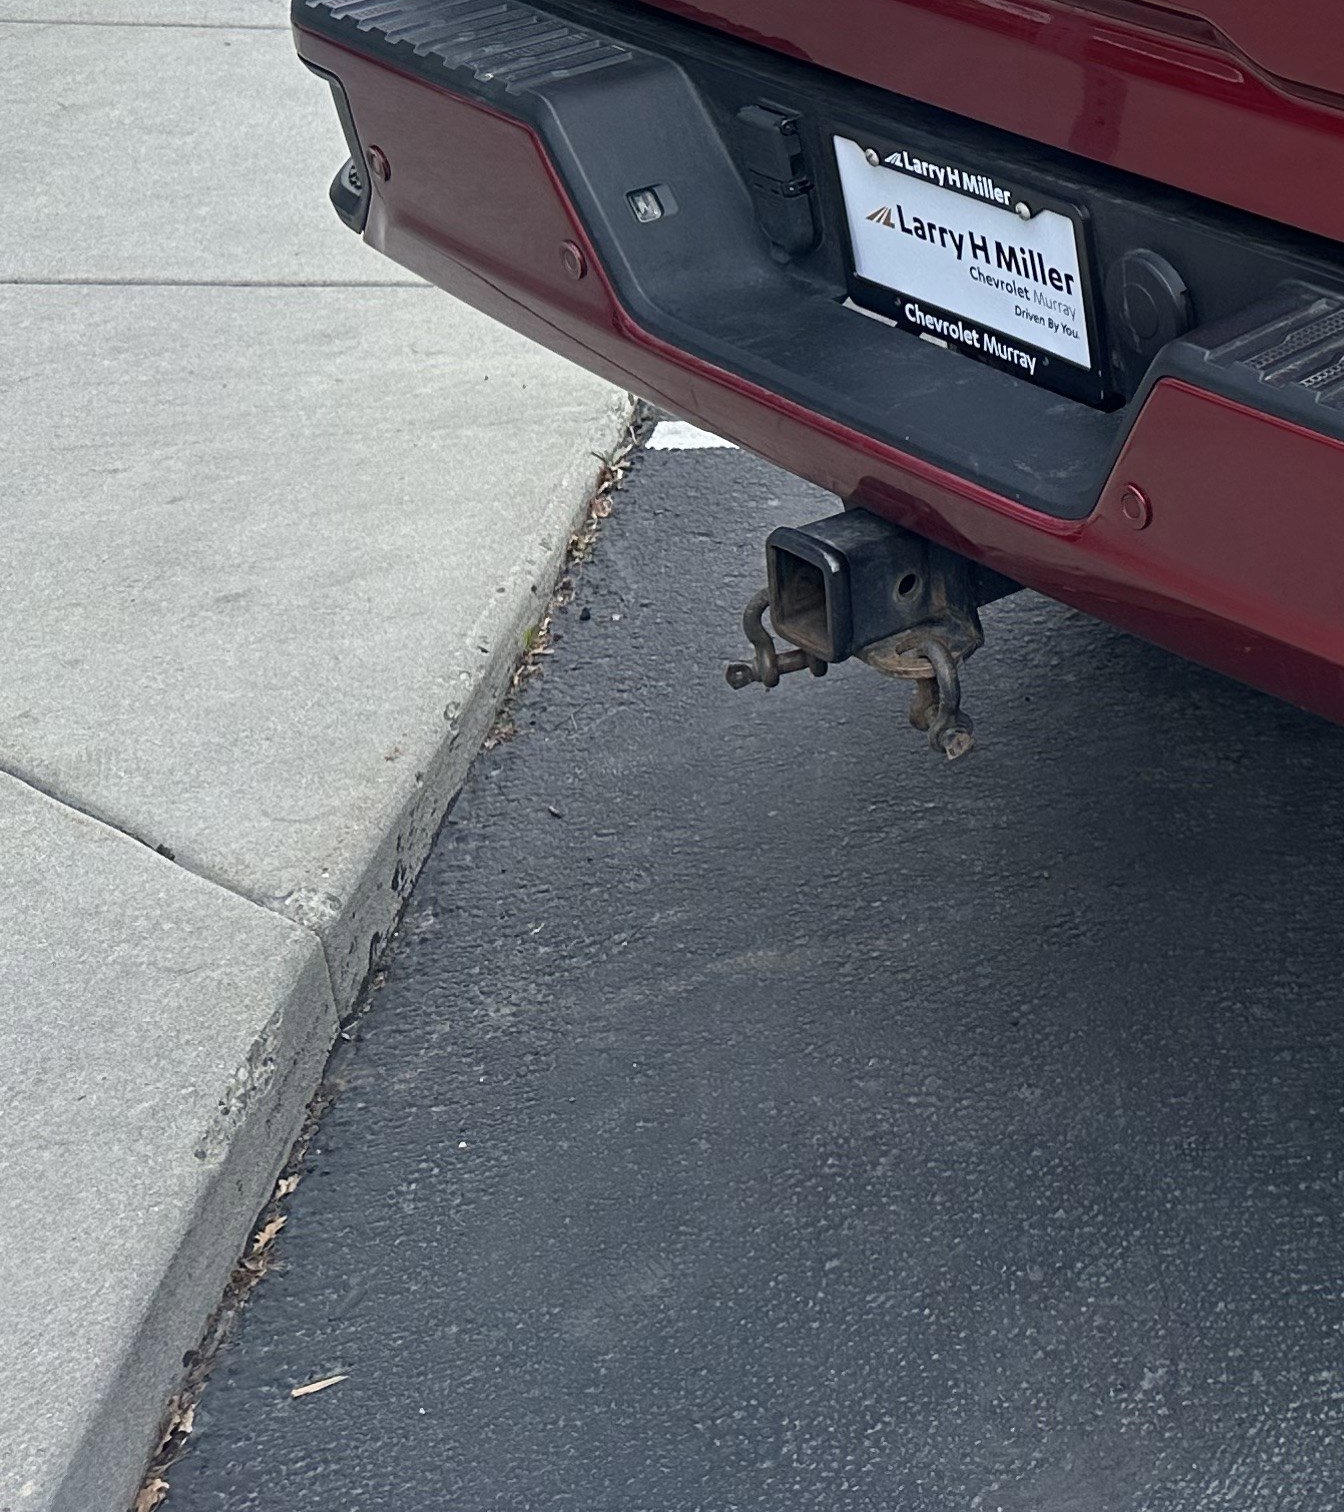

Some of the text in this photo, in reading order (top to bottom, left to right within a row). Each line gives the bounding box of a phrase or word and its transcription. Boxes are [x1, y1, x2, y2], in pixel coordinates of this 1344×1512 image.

[902, 150, 1012, 207] Larry H Miller
[896, 203, 1075, 296] Larry H Miller
[968, 266, 1078, 322] Chevrolet Murray
[1014, 304, 1046, 326] Driven
[1047, 315, 1060, 334] By
[904, 303, 1037, 376] Chevrolet Murray
